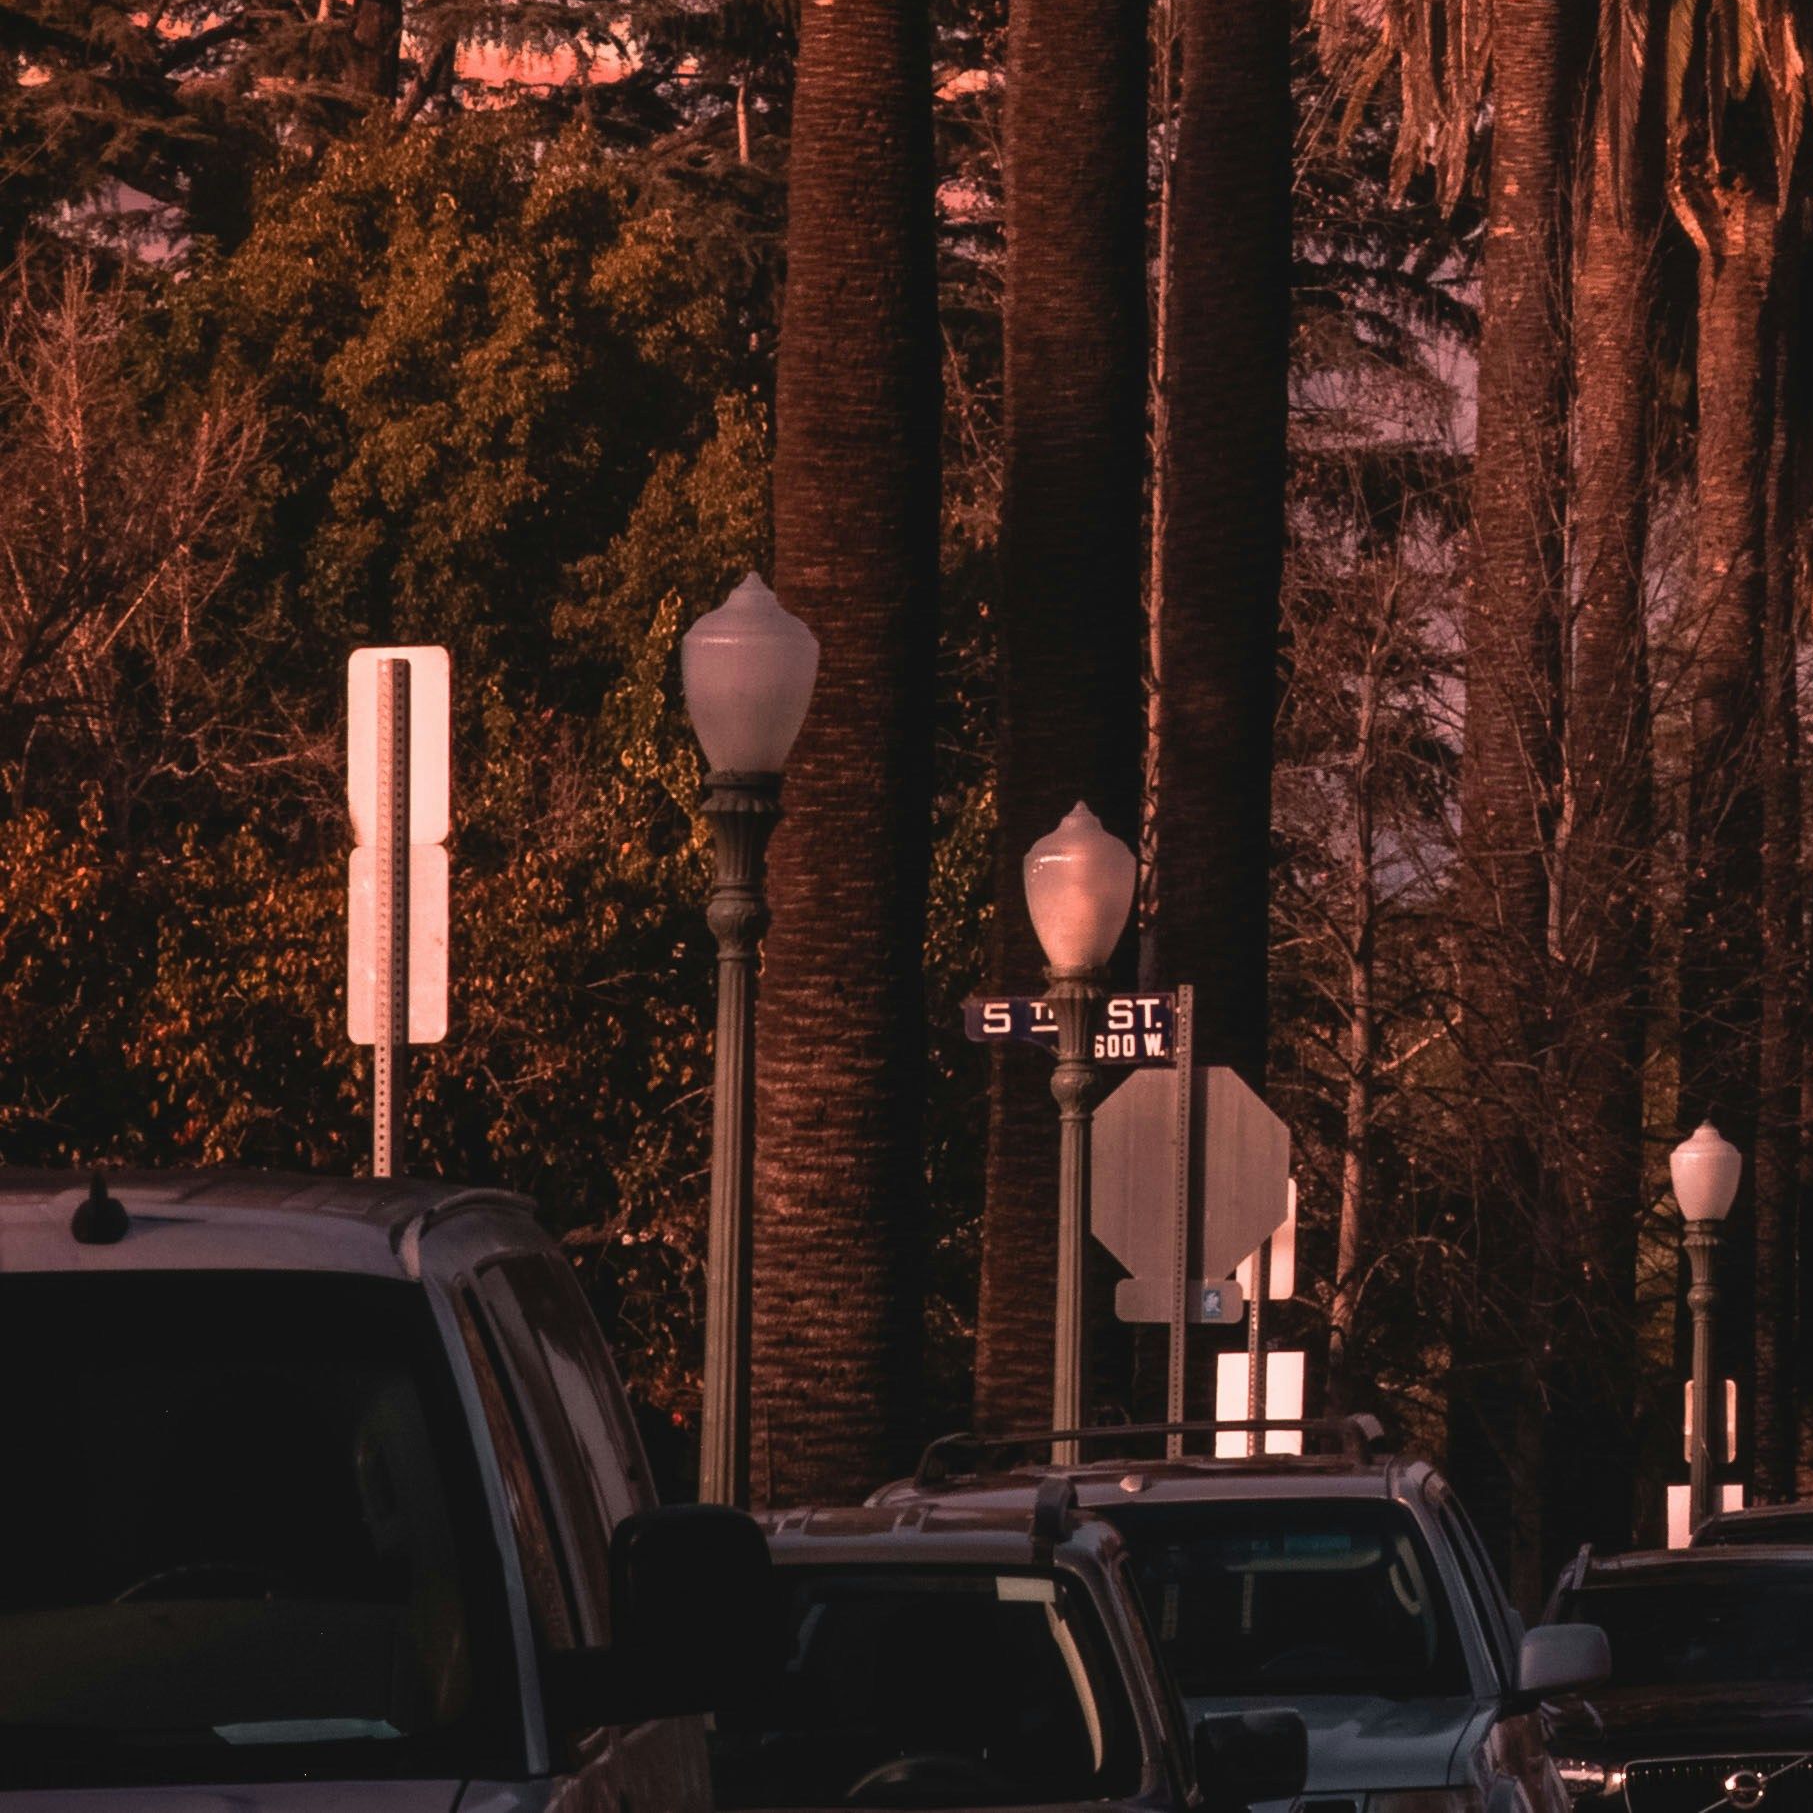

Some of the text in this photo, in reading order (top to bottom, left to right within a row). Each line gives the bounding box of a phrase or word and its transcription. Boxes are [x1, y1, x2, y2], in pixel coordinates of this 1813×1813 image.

[982, 1002, 1012, 1034] 5
[1107, 998, 1162, 1030] ST.
[1094, 1033, 1166, 1059] 600 W.
